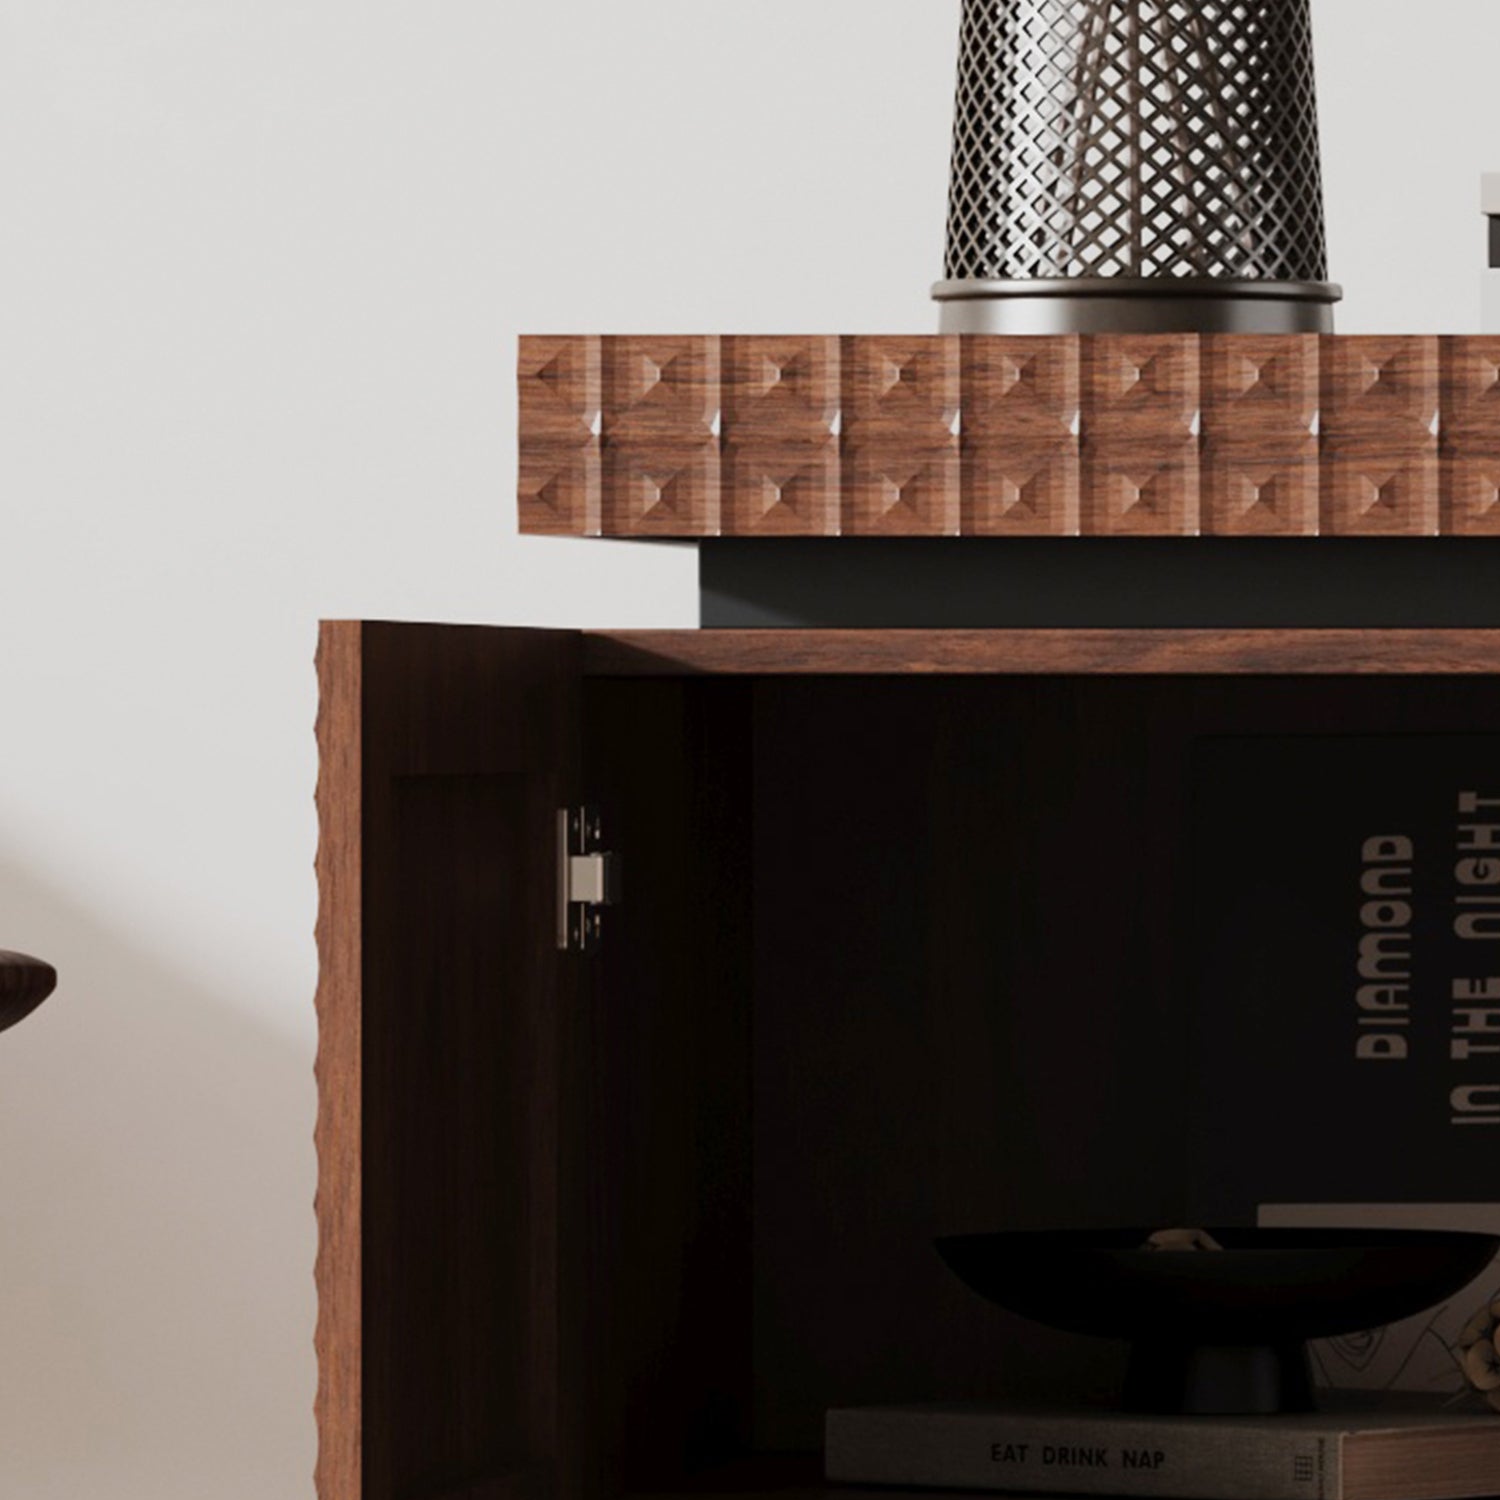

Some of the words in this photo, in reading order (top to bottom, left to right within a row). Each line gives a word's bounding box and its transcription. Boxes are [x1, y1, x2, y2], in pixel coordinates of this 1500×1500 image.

[1355, 834, 1414, 1060] DIAMOND
[990, 1443, 1029, 1463] EAT
[1042, 1445, 1108, 1467] DRINK
[1122, 1449, 1165, 1470] NAP
